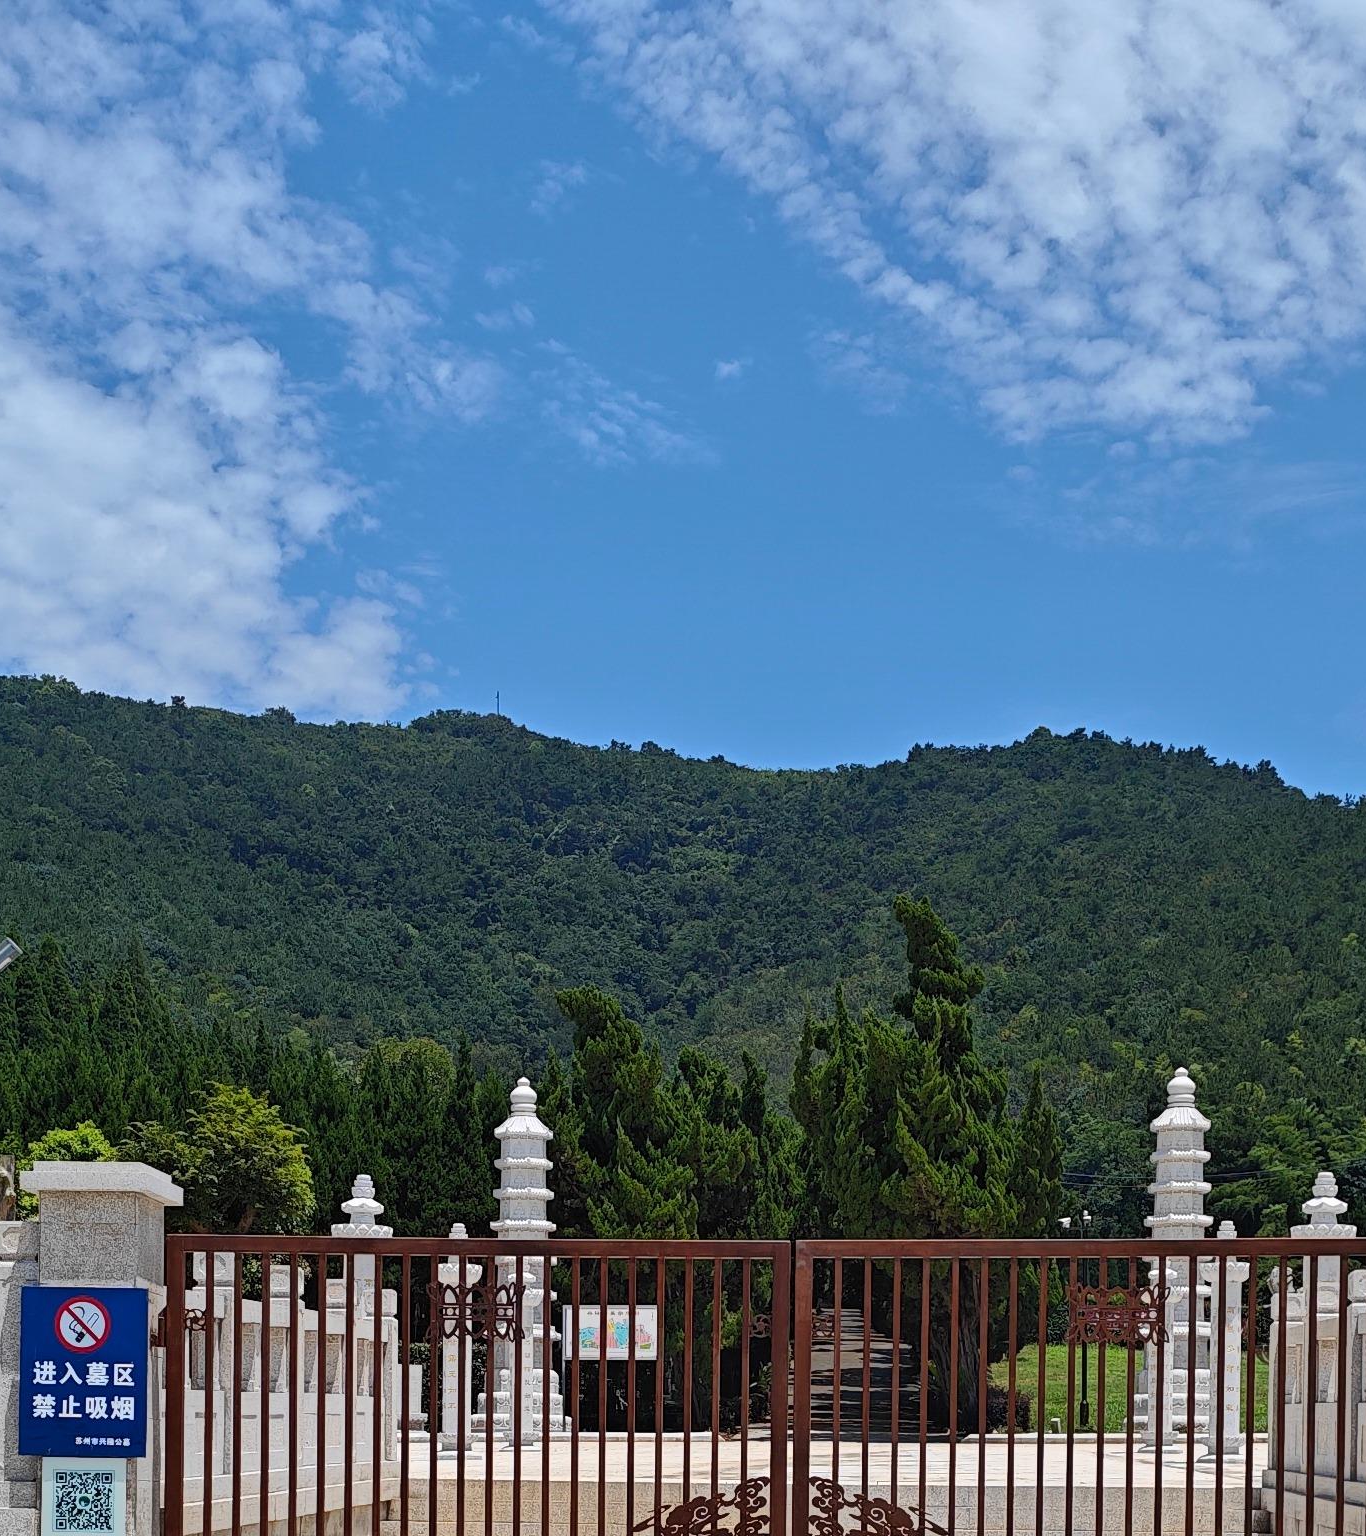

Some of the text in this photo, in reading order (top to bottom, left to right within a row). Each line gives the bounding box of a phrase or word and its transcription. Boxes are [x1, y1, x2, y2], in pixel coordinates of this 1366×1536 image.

[33, 1361, 135, 1386] 进入墓区
[32, 1394, 135, 1420] 禁止吸烟
